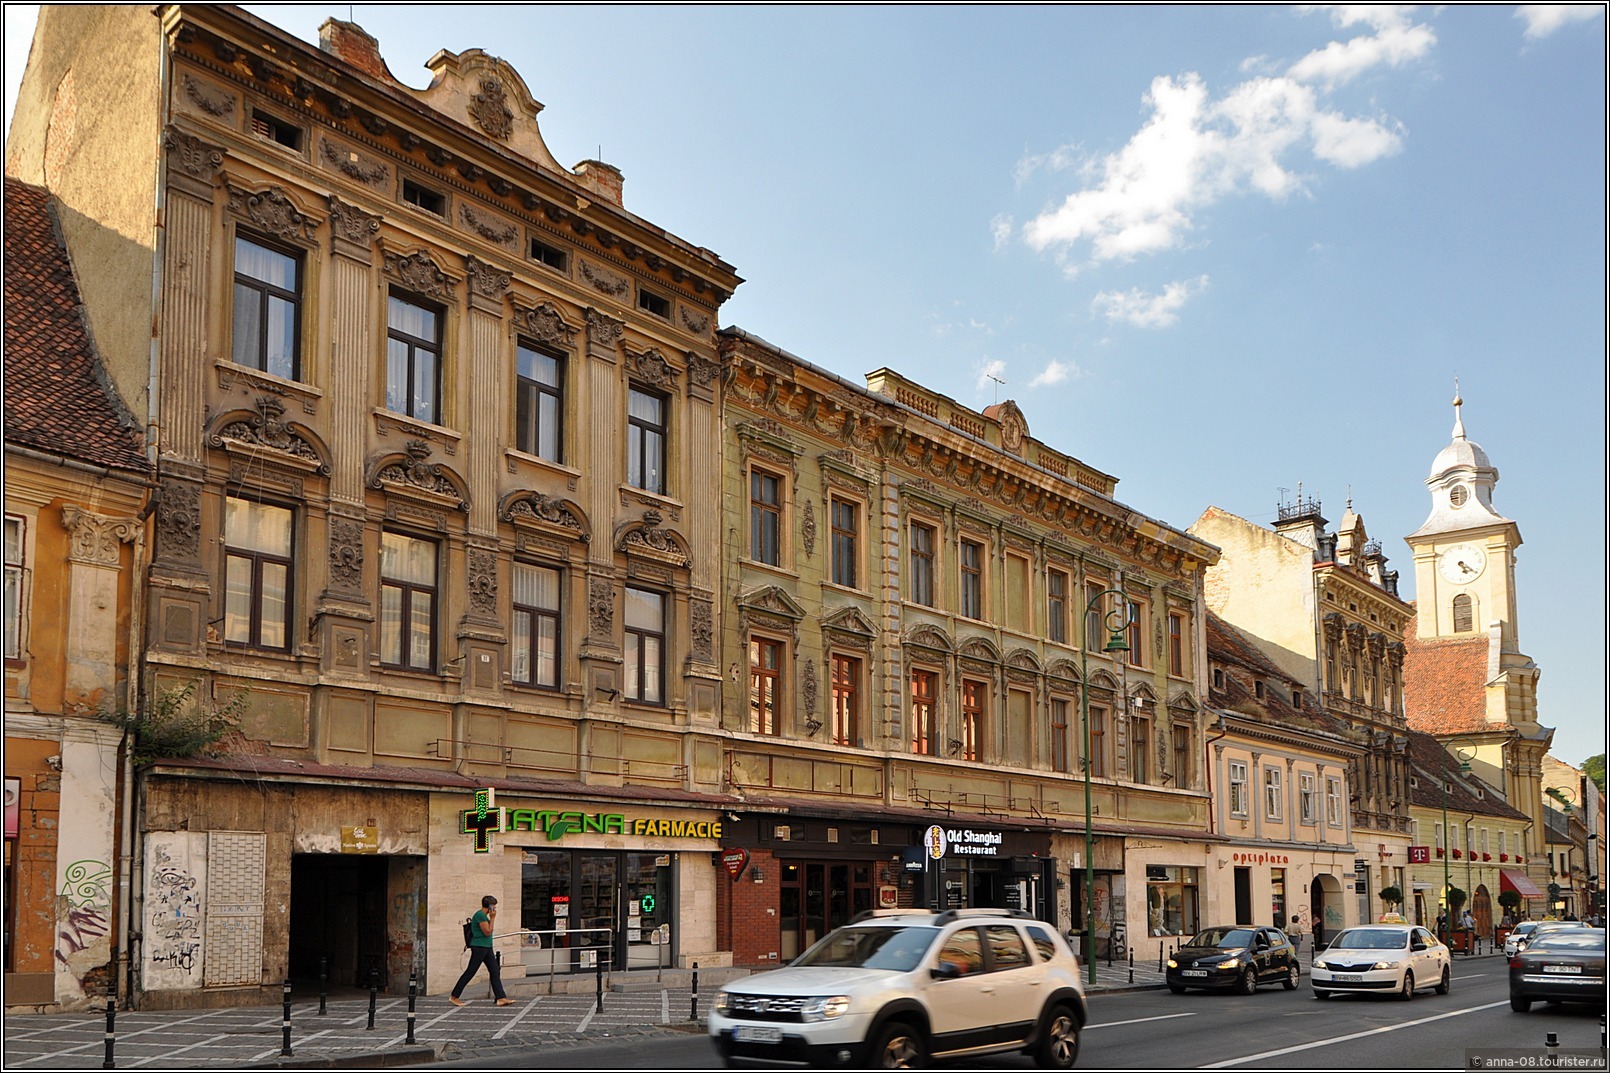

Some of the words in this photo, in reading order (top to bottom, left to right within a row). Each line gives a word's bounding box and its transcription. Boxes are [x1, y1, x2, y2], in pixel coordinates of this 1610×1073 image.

[633, 819, 722, 838] FARMACIE
[946, 829, 963, 843] Old
[964, 829, 1002, 846] Shanghai
[954, 844, 997, 855] Restaurant
[1233, 852, 1289, 866] optiplaza
